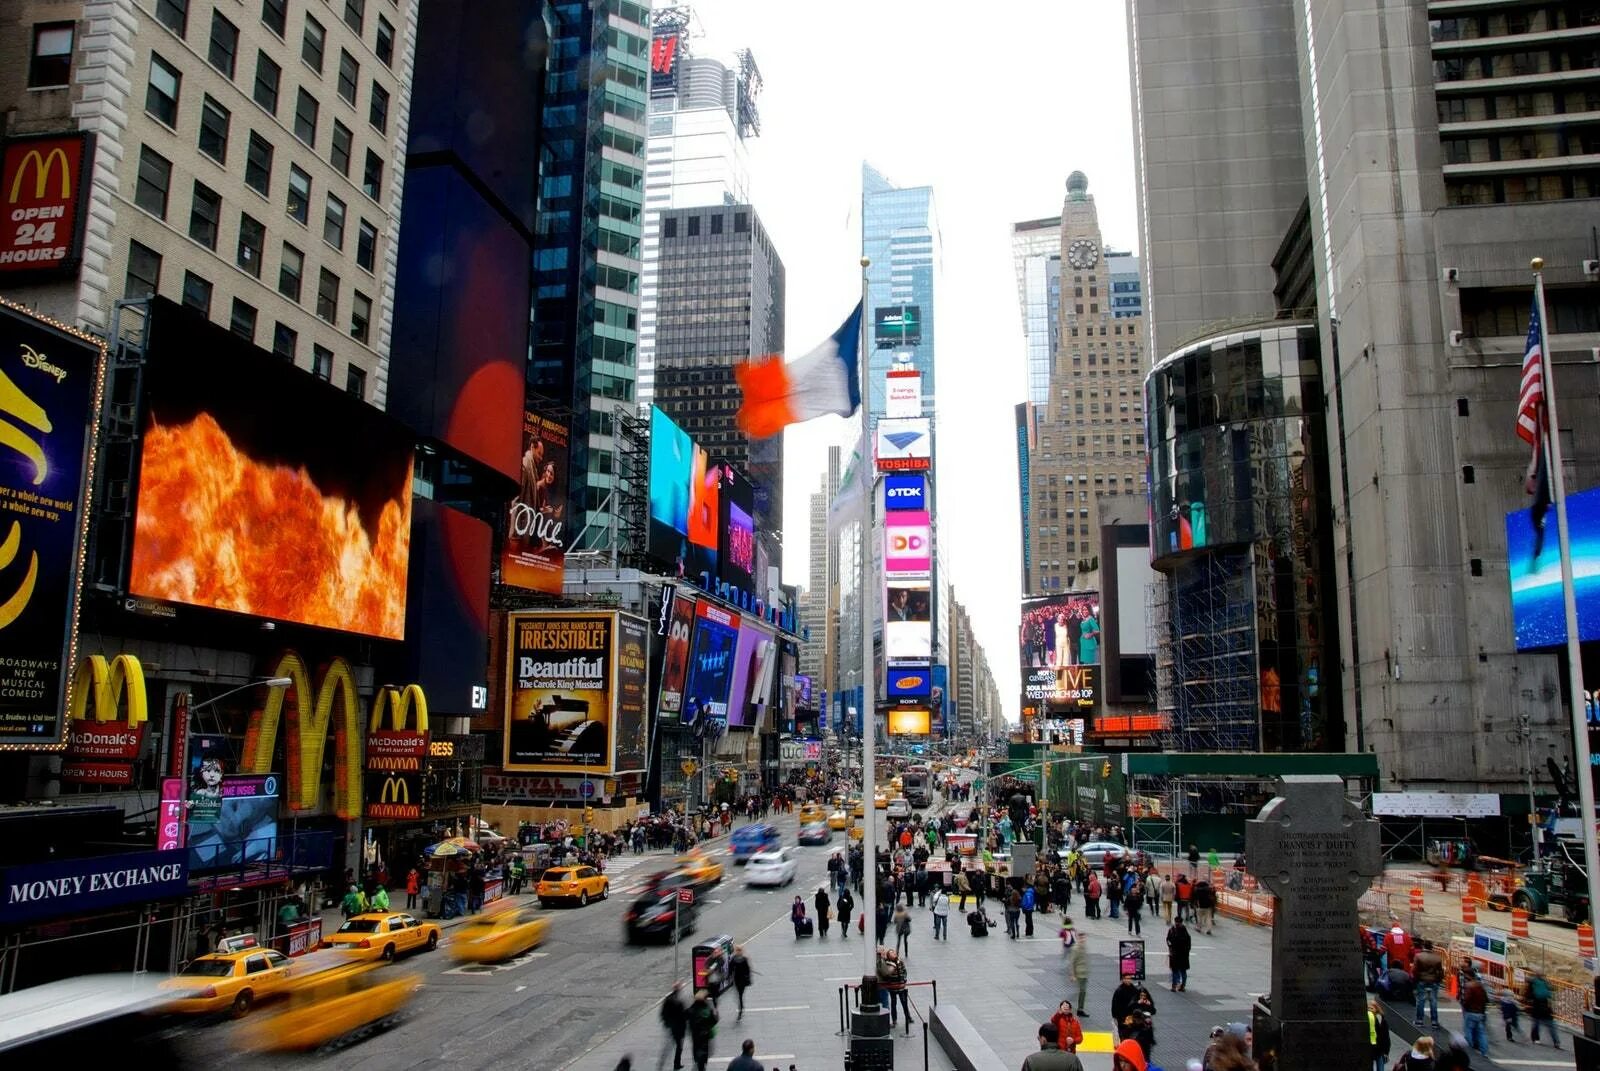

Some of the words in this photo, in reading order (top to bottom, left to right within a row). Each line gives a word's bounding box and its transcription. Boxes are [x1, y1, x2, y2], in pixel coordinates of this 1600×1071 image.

[11, 205, 65, 221] OPEN
[14, 222, 56, 246] 24
[0, 246, 66, 264] HOURS
[20, 343, 67, 384] Disney
[879, 459, 930, 471] TOSHIBA
[895, 488, 921, 497] TDK
[18, 490, 39, 503] whole
[40, 496, 53, 506] new
[54, 500, 73, 512] world
[9, 502, 30, 514] whole
[31, 507, 45, 517] new
[14, 669, 36, 678] NEW
[519, 656, 603, 678] Beautiful
[1, 679, 46, 689] MUSICAL
[519, 679, 533, 689] The
[533, 679, 557, 689] Carole
[557, 679, 575, 692] King
[575, 679, 603, 689] Musical
[1, 688, 44, 698] COMEDY
[1026, 691, 1044, 699] WED
[1045, 690, 1070, 699] MARCH
[1071, 690, 1081, 699] 26
[68, 732, 137, 746] McDonald's
[368, 737, 425, 747] McDonald's
[73, 745, 123, 754] Restaurant
[62, 768, 85, 777] OPEN
[87, 769, 97, 777] 24
[99, 769, 128, 778] HOURS
[8, 875, 86, 904] MONEY
[89, 863, 182, 892] EXCHANGE
